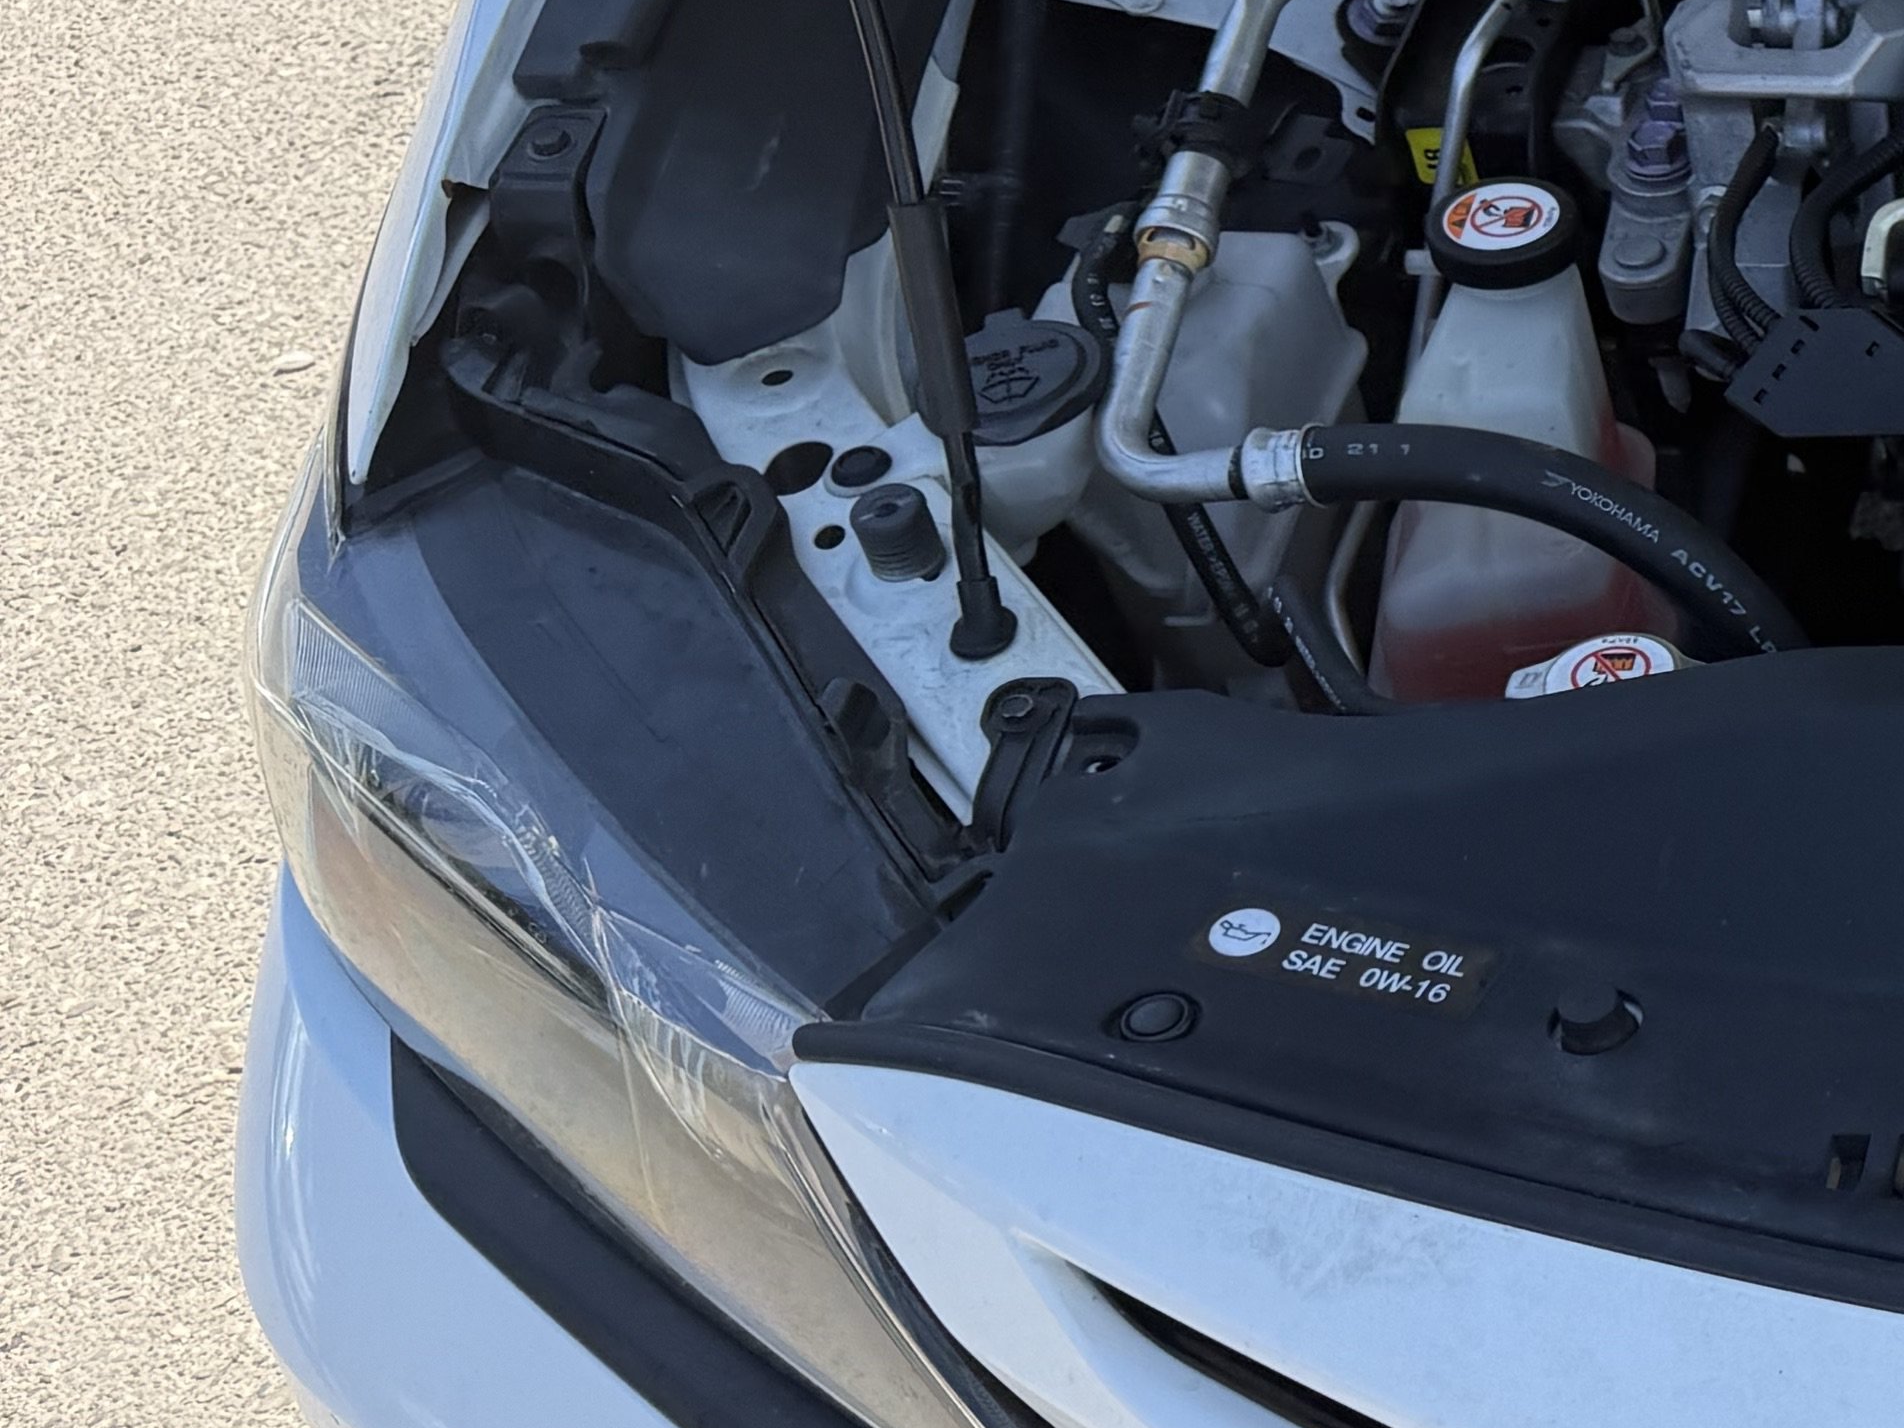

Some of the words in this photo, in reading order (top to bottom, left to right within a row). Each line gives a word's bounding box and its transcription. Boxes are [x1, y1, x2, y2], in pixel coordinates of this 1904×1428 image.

[1570, 481, 1660, 544] YOKOHAMA
[1669, 549, 1747, 615] ACV17
[1281, 949, 1347, 979] SAE
[1359, 967, 1451, 1003] 0W-16
[1300, 922, 1411, 963] ENGINE
[1421, 950, 1465, 978] OIL
